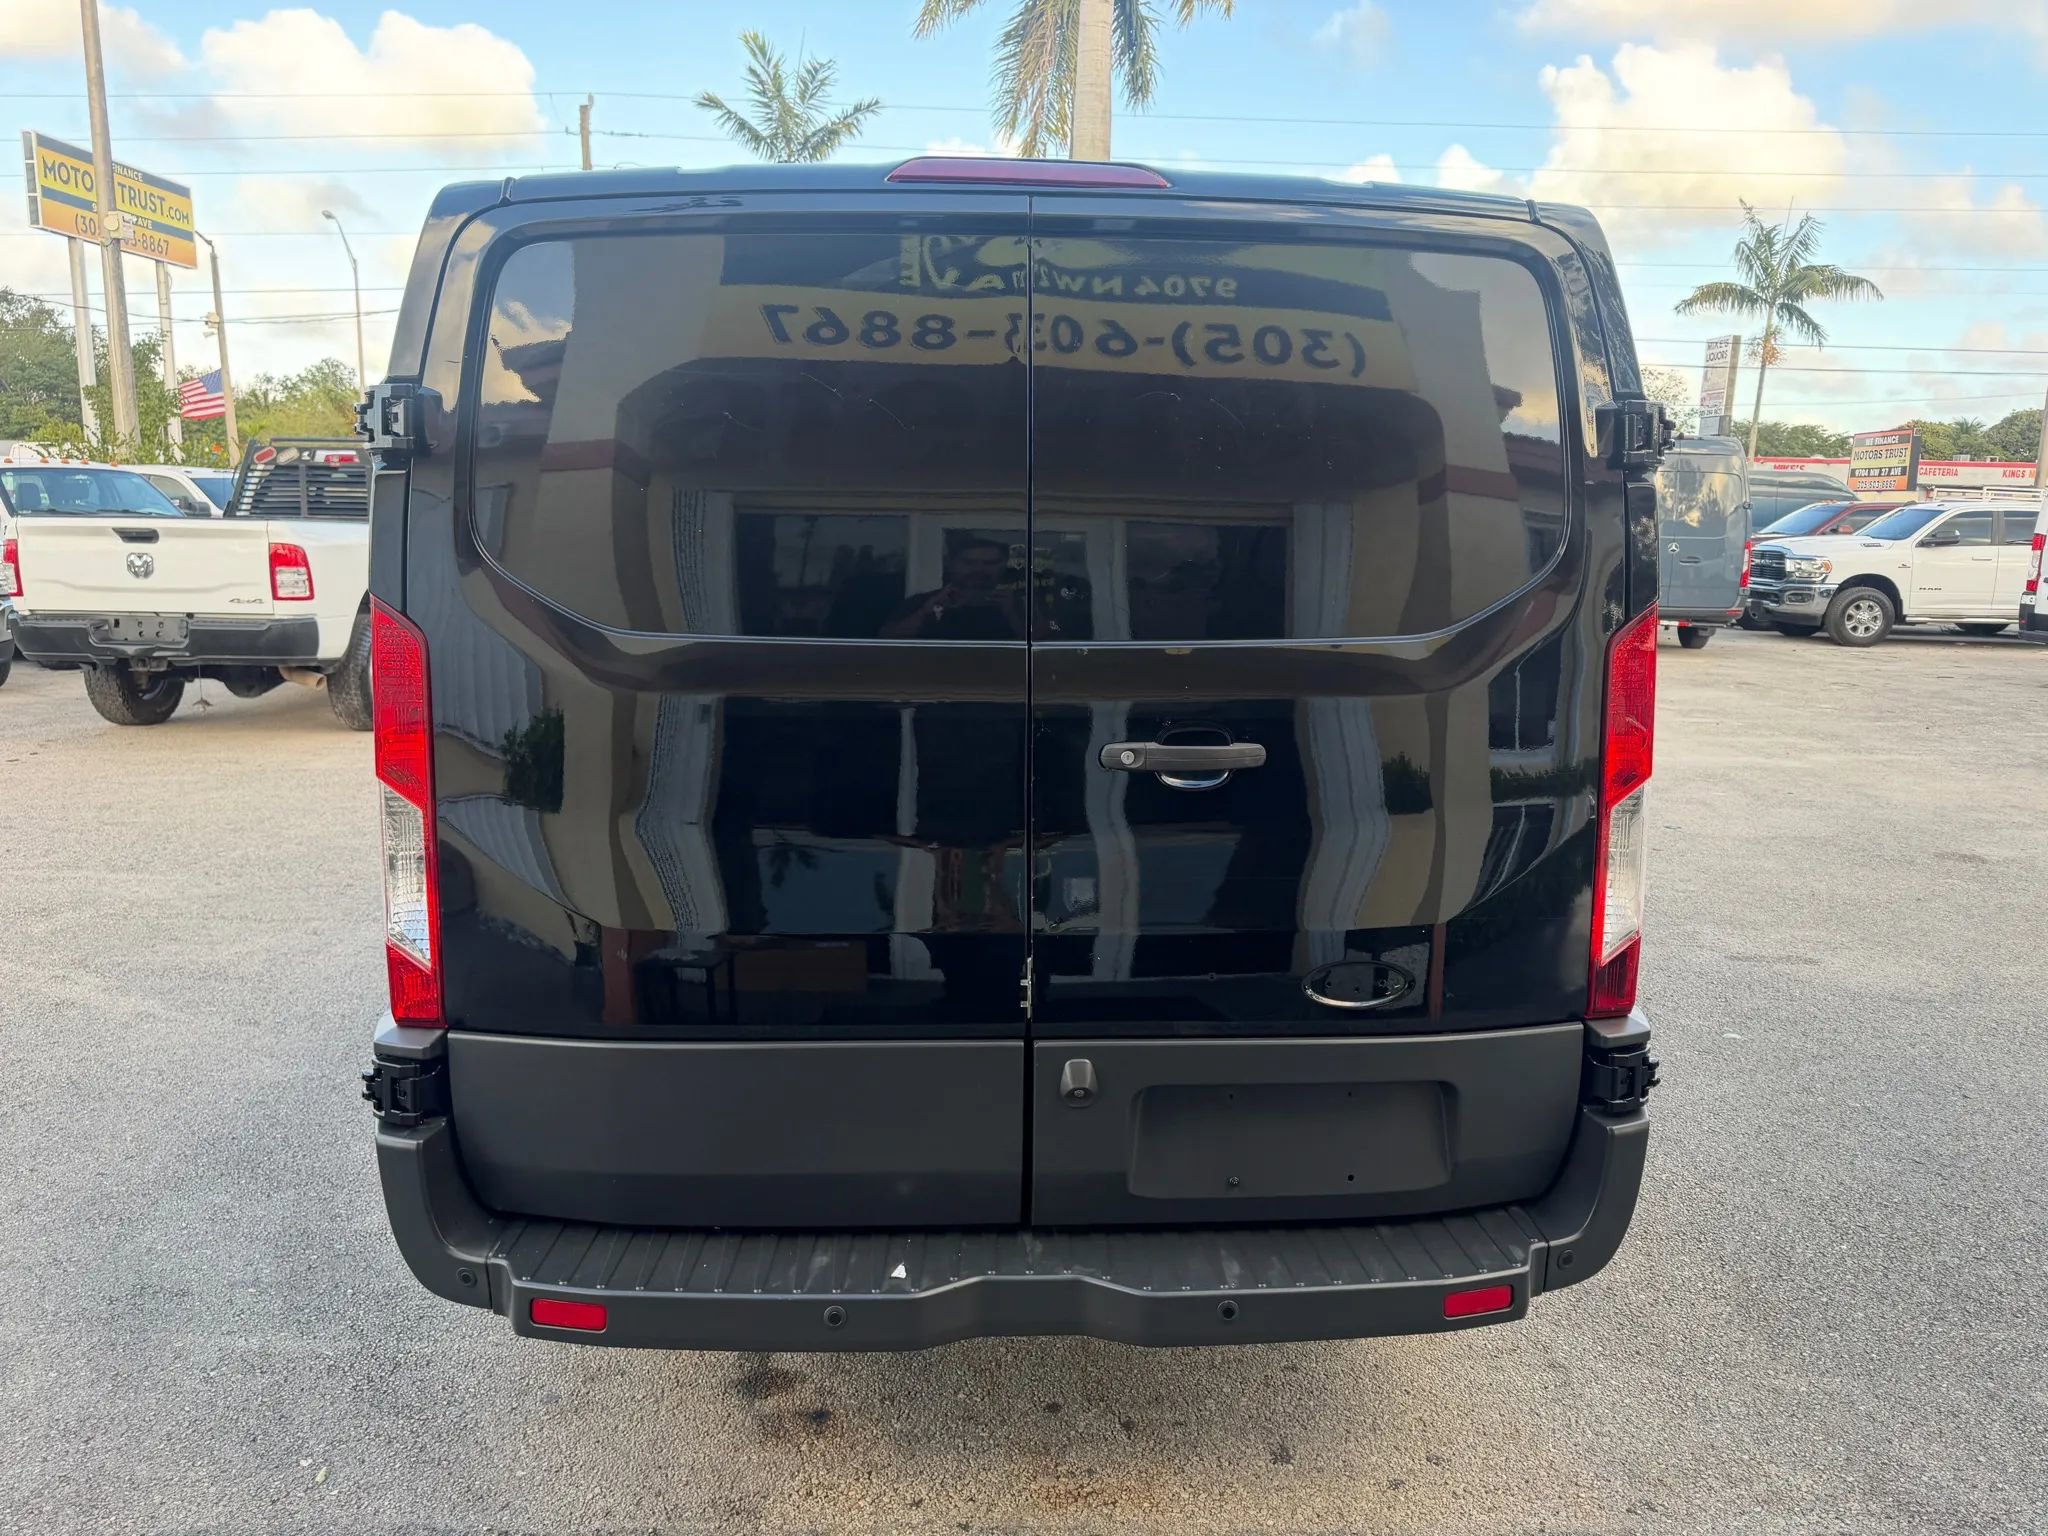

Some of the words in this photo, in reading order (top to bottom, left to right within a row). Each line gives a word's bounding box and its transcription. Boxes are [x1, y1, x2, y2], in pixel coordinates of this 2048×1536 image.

[42, 155, 94, 192] MOTO
[117, 182, 190, 225] TRUST.COM
[75, 213, 100, 236] (30
[123, 231, 169, 256] 3-8867
[1706, 350, 1728, 362] LIQUORS
[1875, 435, 1899, 445] FINANCE
[1853, 449, 1883, 460] MOTORS
[1885, 447, 1908, 459] TRUST
[1890, 467, 1901, 475] AVE
[1919, 467, 1958, 477] CAFETERIA
[2002, 469, 2026, 478] KINGS
